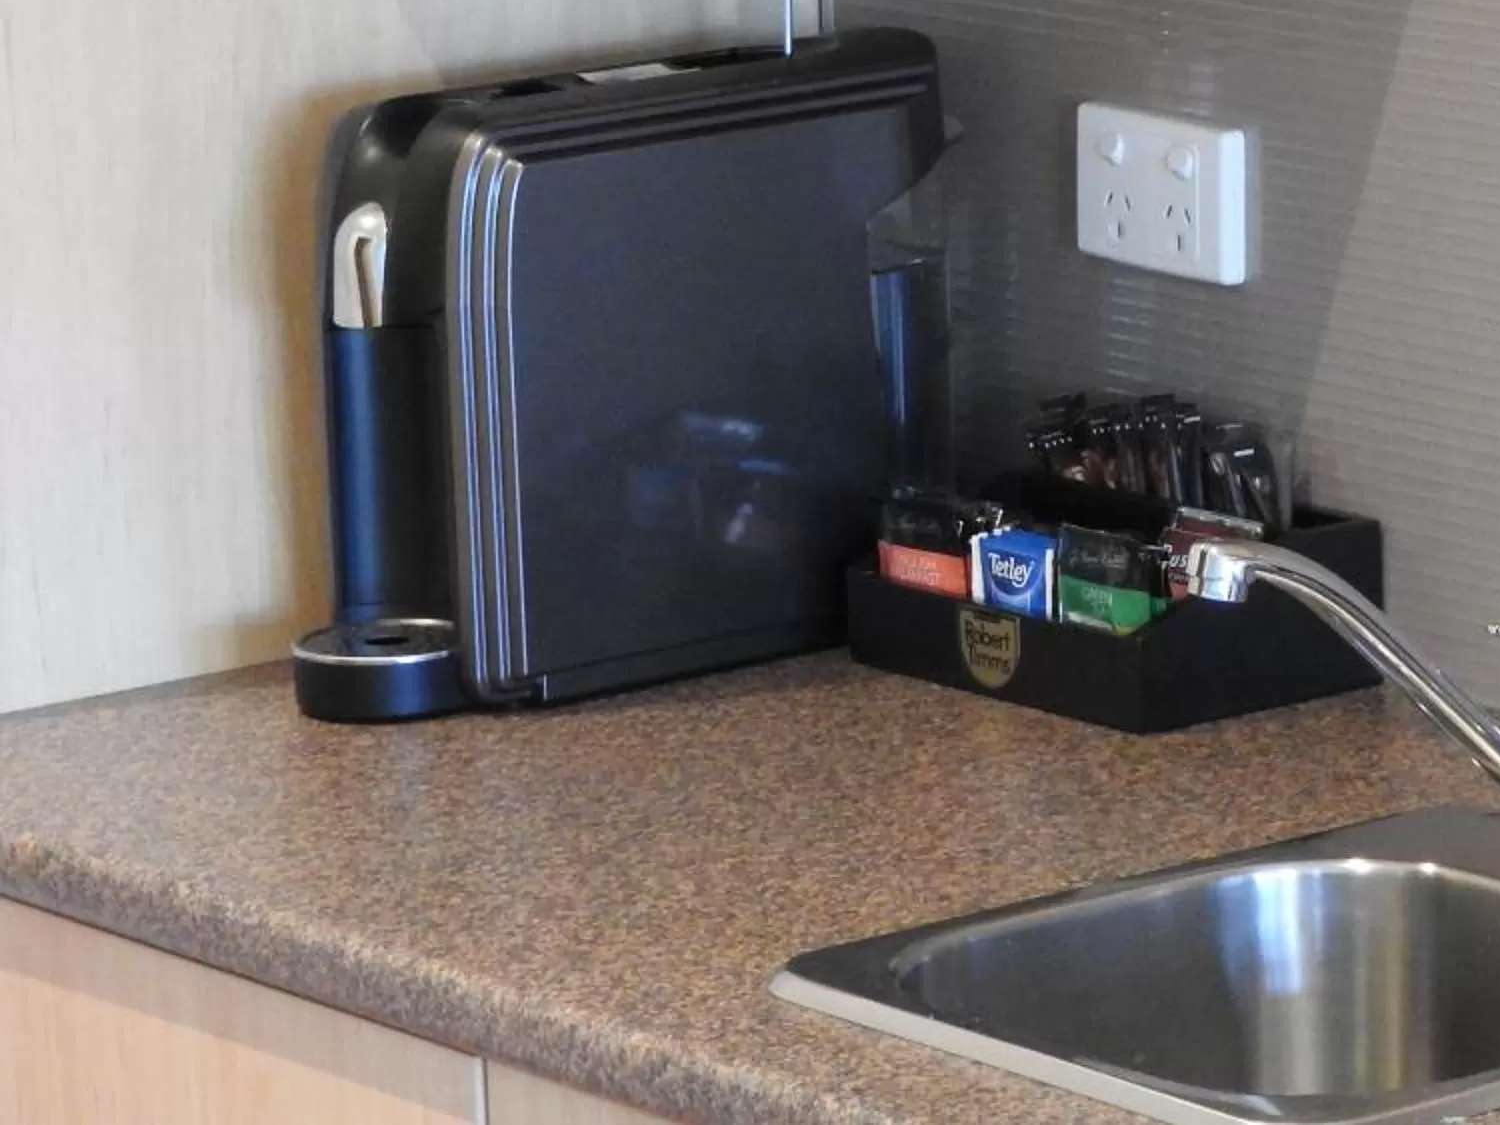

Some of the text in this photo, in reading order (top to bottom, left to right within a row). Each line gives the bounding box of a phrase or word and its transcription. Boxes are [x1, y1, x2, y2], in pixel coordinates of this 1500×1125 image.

[987, 552, 1036, 588] Tetley
[965, 620, 1010, 652] Robert
[969, 646, 1011, 674] Timms
